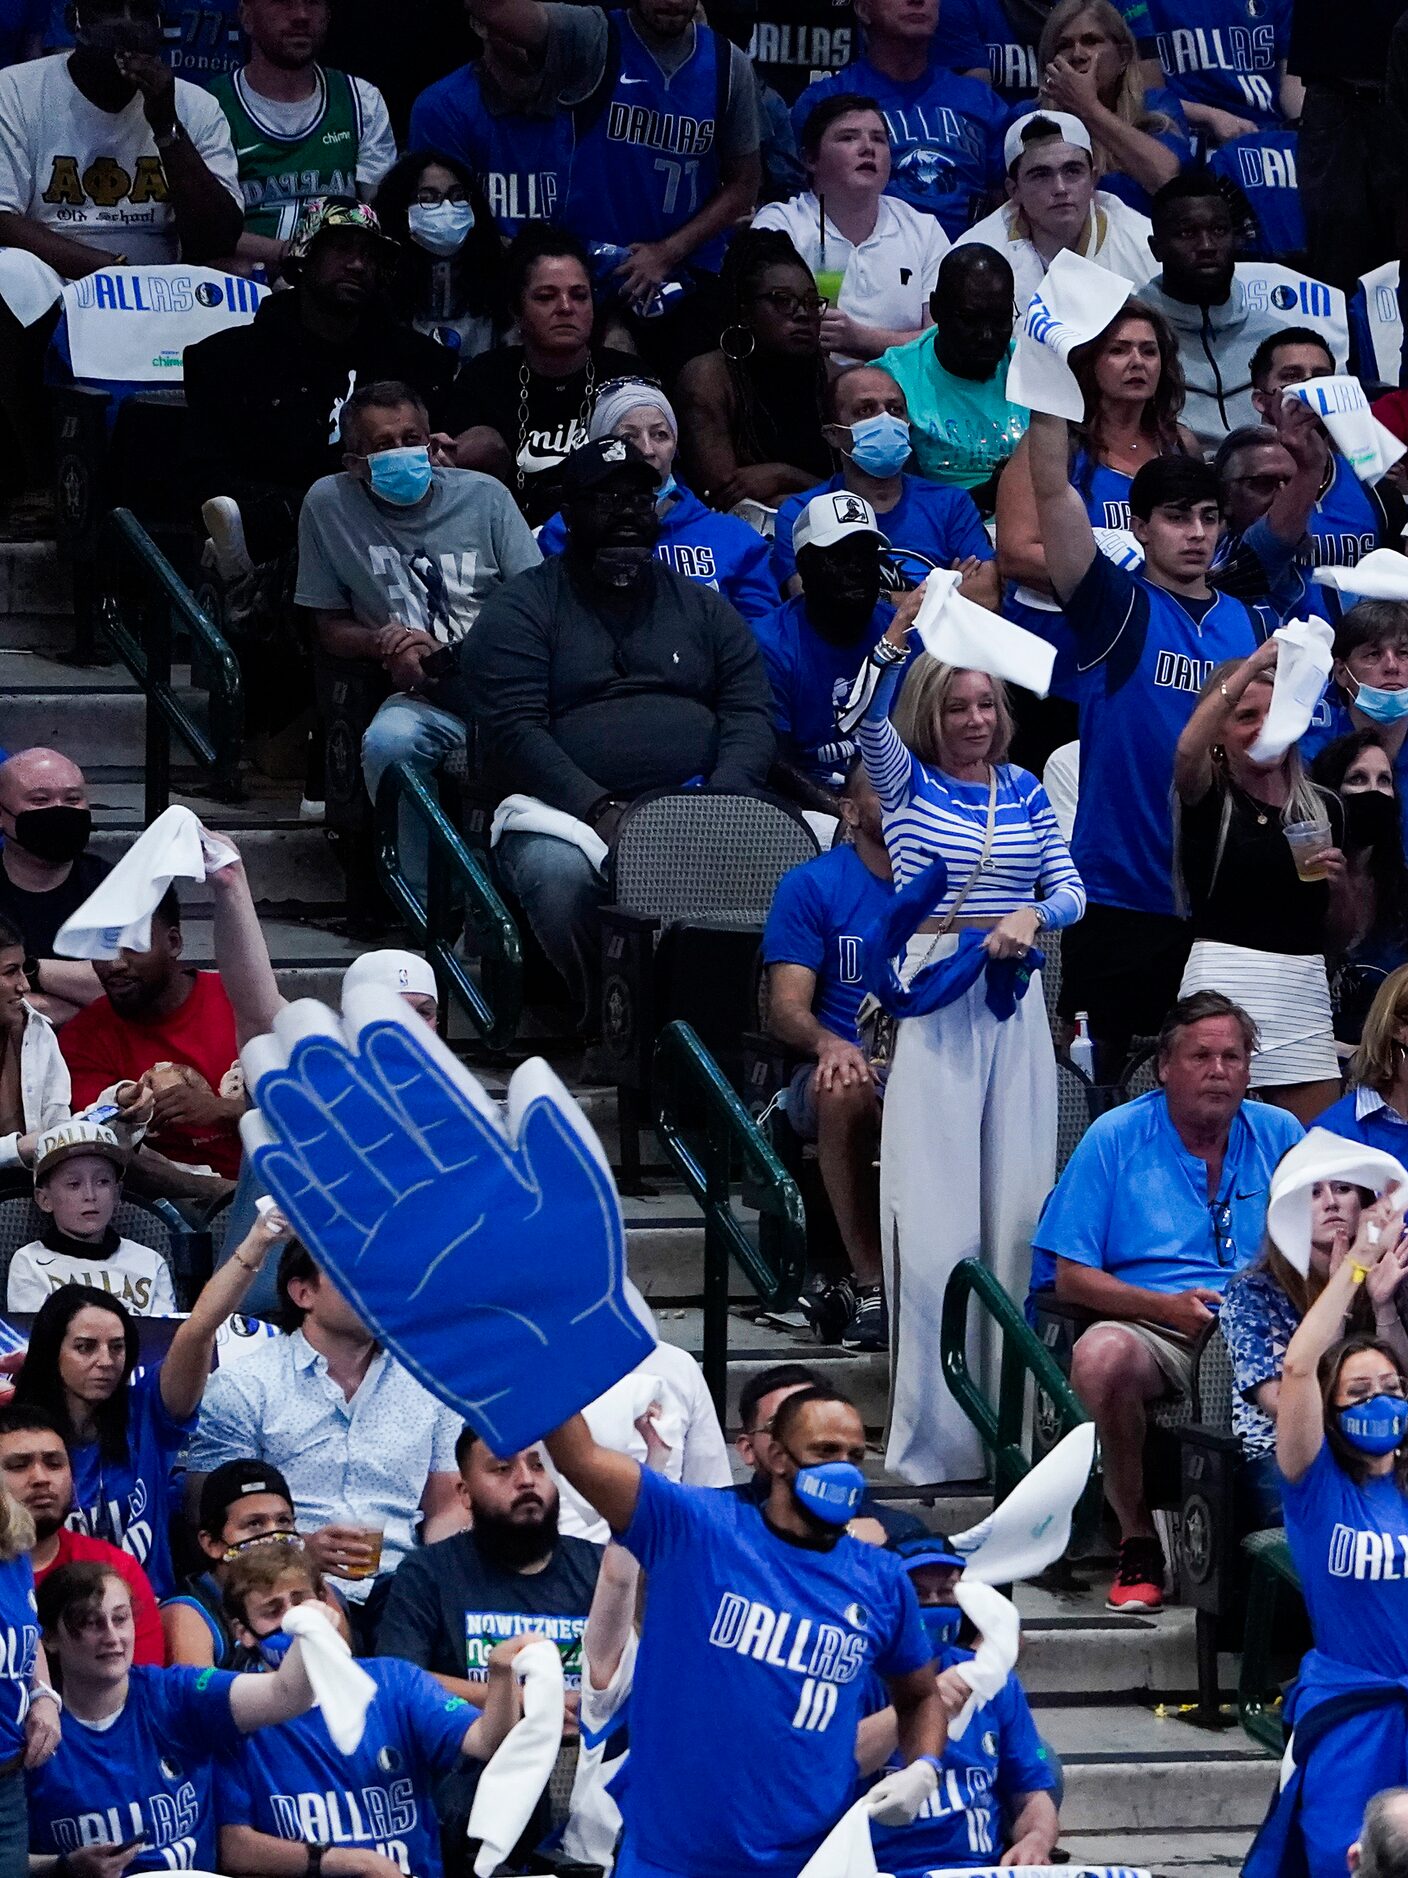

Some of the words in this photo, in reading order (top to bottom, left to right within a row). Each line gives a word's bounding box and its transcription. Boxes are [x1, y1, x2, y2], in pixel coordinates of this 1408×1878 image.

[1156, 25, 1275, 76] DALLAS
[606, 101, 714, 155] DALLAS
[74, 274, 194, 313] DALLAS
[44, 1126, 118, 1154] DALLAS
[708, 1590, 870, 1683] DALLAS
[268, 1778, 418, 1847] DALLAS
